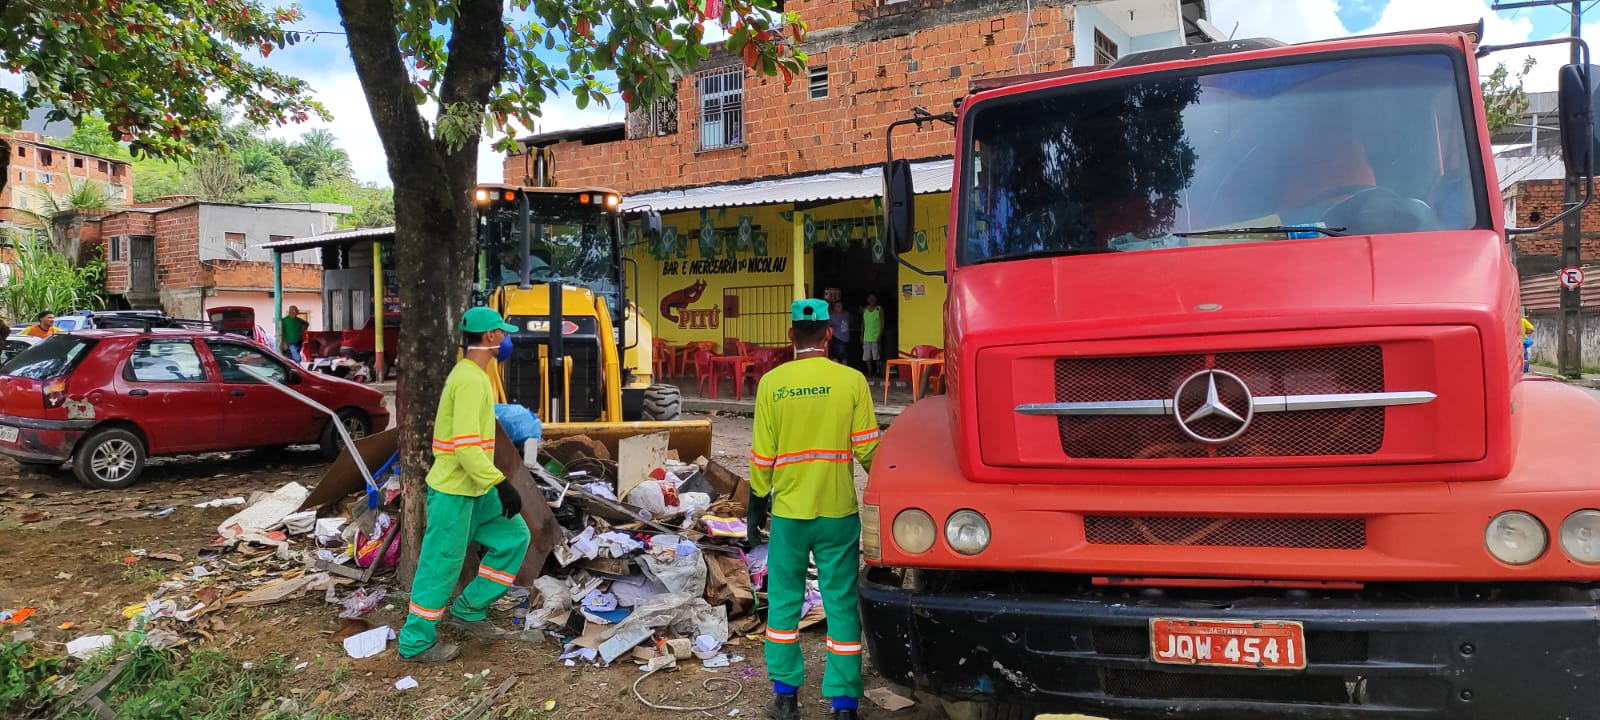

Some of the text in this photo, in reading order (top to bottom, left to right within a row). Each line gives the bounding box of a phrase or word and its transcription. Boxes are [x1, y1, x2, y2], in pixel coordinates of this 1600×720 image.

[662, 260, 679, 276] BAR
[682, 261, 688, 275] E
[689, 258, 738, 275] MERCEARIA
[747, 256, 787, 273] NICOLAU
[1568, 272, 1577, 283] E
[678, 303, 721, 330] PITÚ
[772, 385, 832, 403] biosanear
[1159, 634, 1295, 663] JQW 4541
